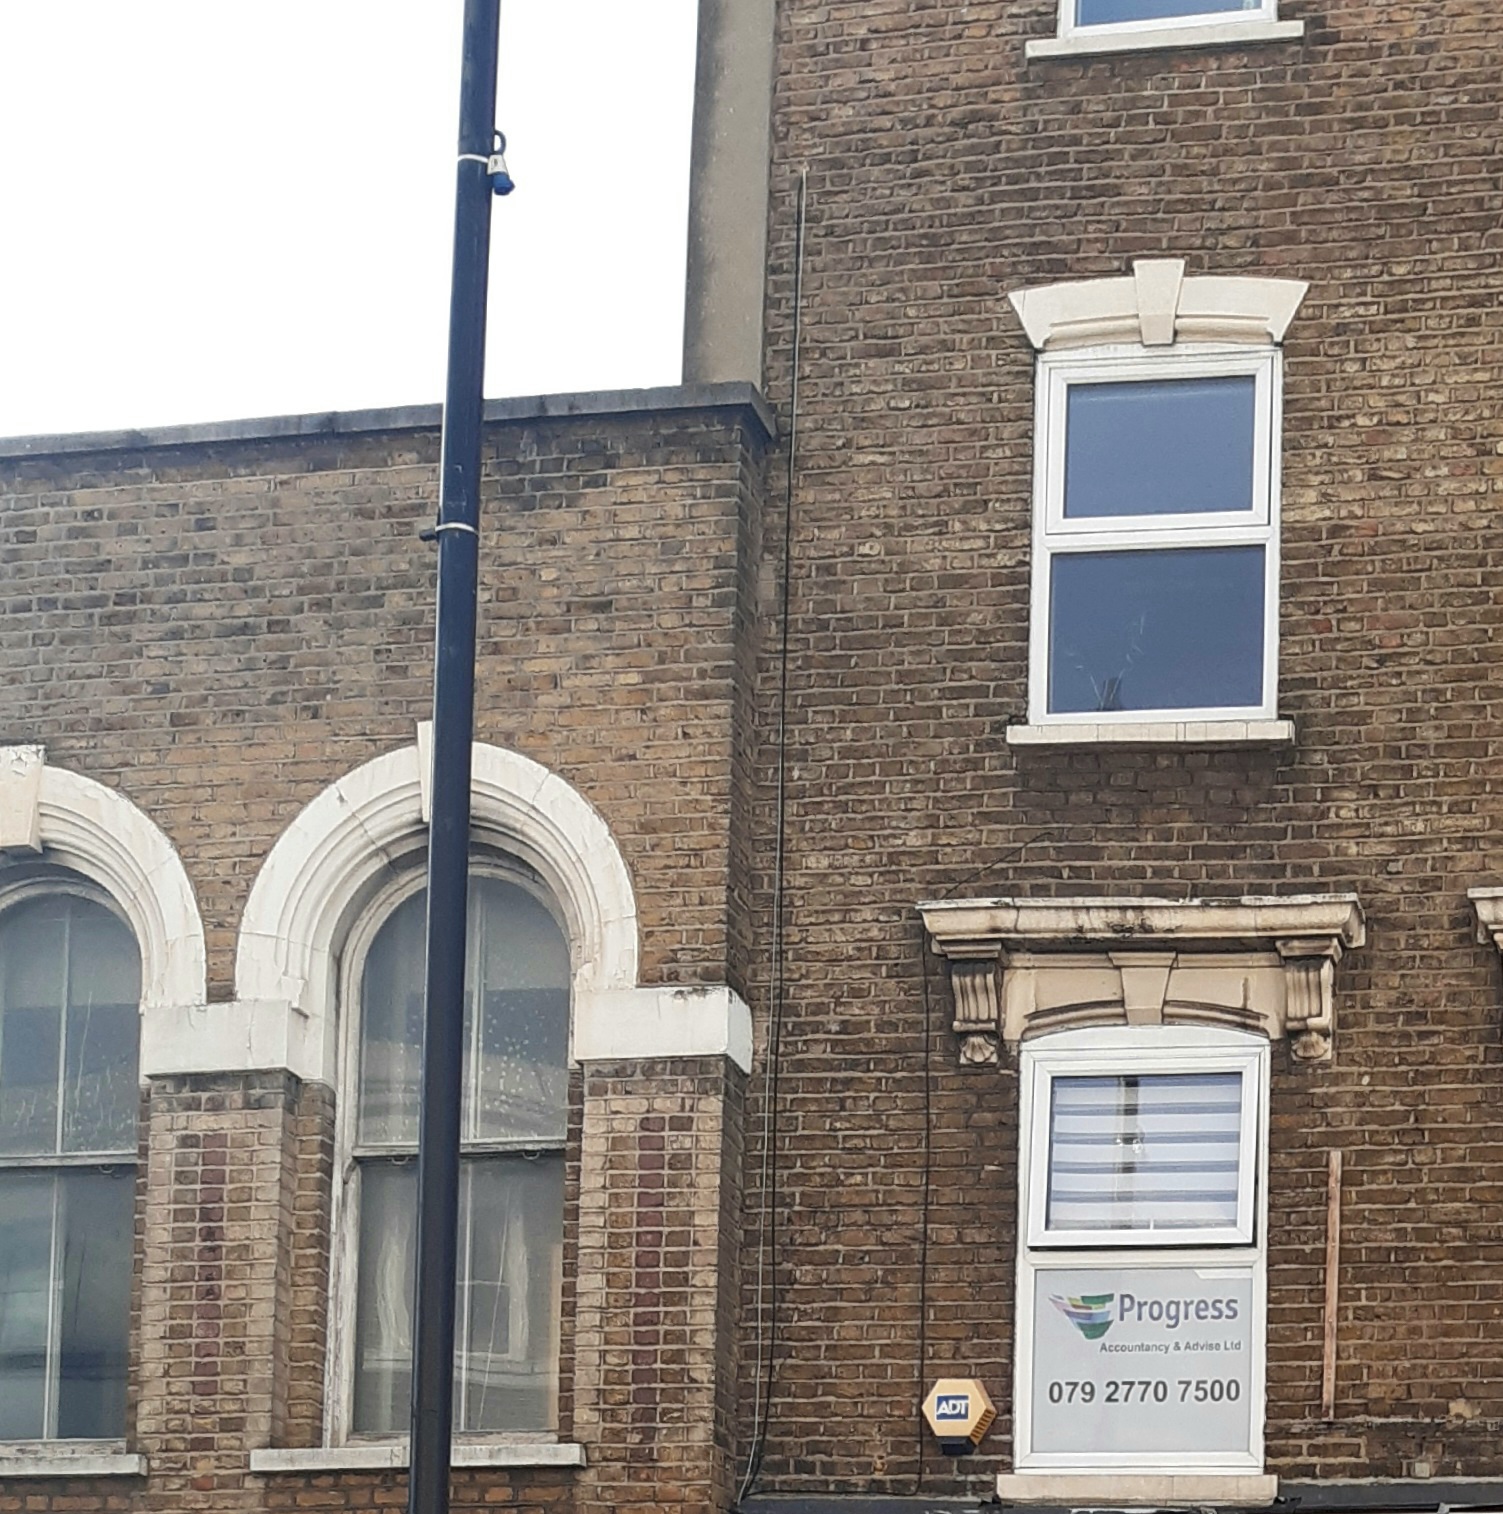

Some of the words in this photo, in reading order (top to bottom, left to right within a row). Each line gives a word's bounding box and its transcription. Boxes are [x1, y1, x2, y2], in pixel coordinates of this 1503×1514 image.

[1119, 1293, 1239, 1328] Progress
[1100, 1342, 1170, 1354] Accountancy
[1173, 1342, 1181, 1351] &
[1184, 1341, 1221, 1351] Advise
[1223, 1340, 1242, 1351] Ltd
[1049, 1381, 1095, 1403] 079
[1105, 1380, 1168, 1402] 2770
[1177, 1379, 1240, 1402] 7500
[937, 1400, 969, 1416] ADT
